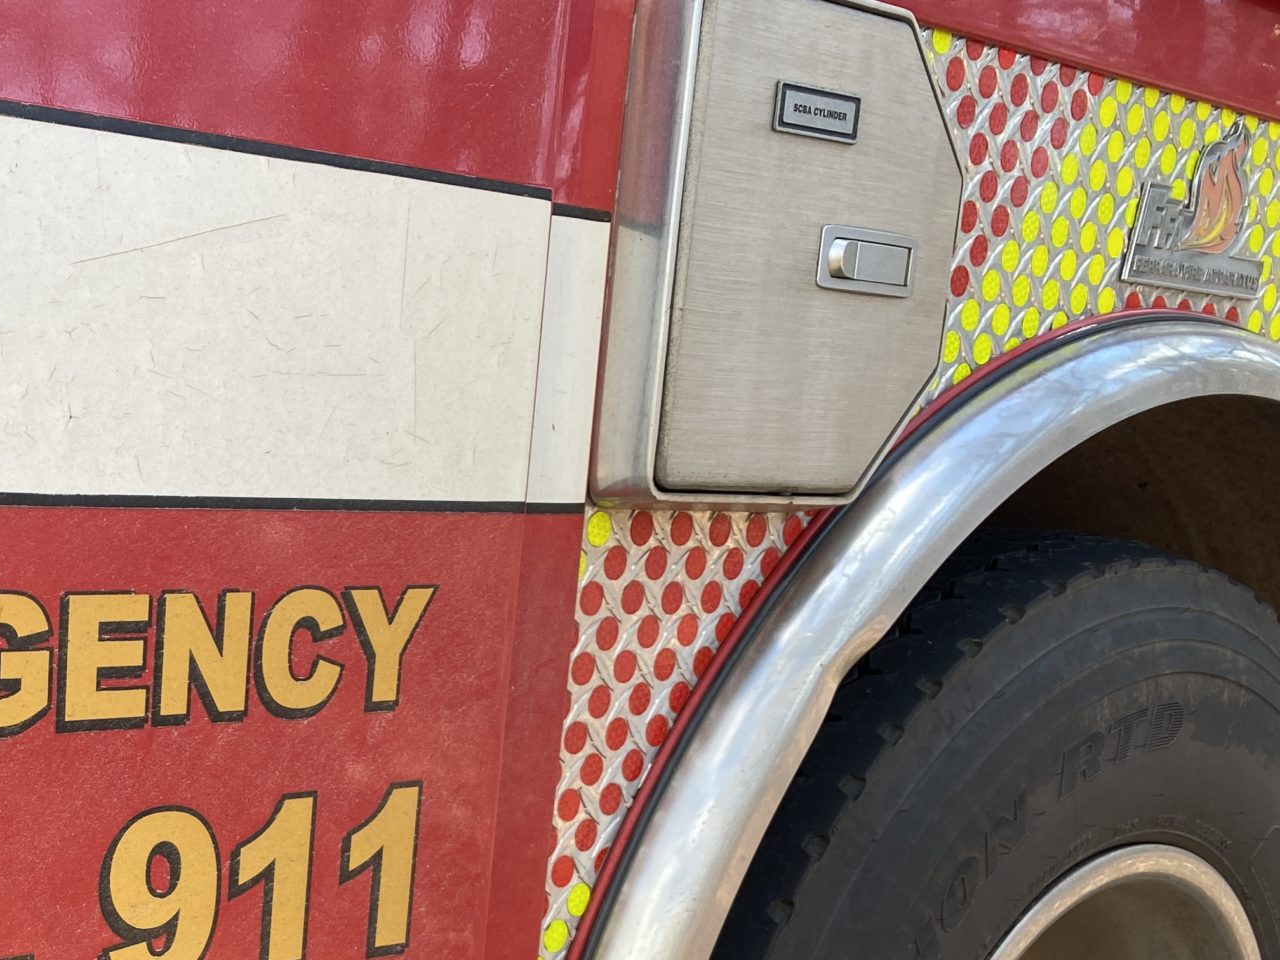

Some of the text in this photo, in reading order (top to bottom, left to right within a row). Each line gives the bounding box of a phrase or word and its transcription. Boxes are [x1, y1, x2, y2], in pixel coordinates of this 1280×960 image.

[793, 103, 848, 121] SCBA CYLINDER
[1058, 702, 1184, 800] RTD
